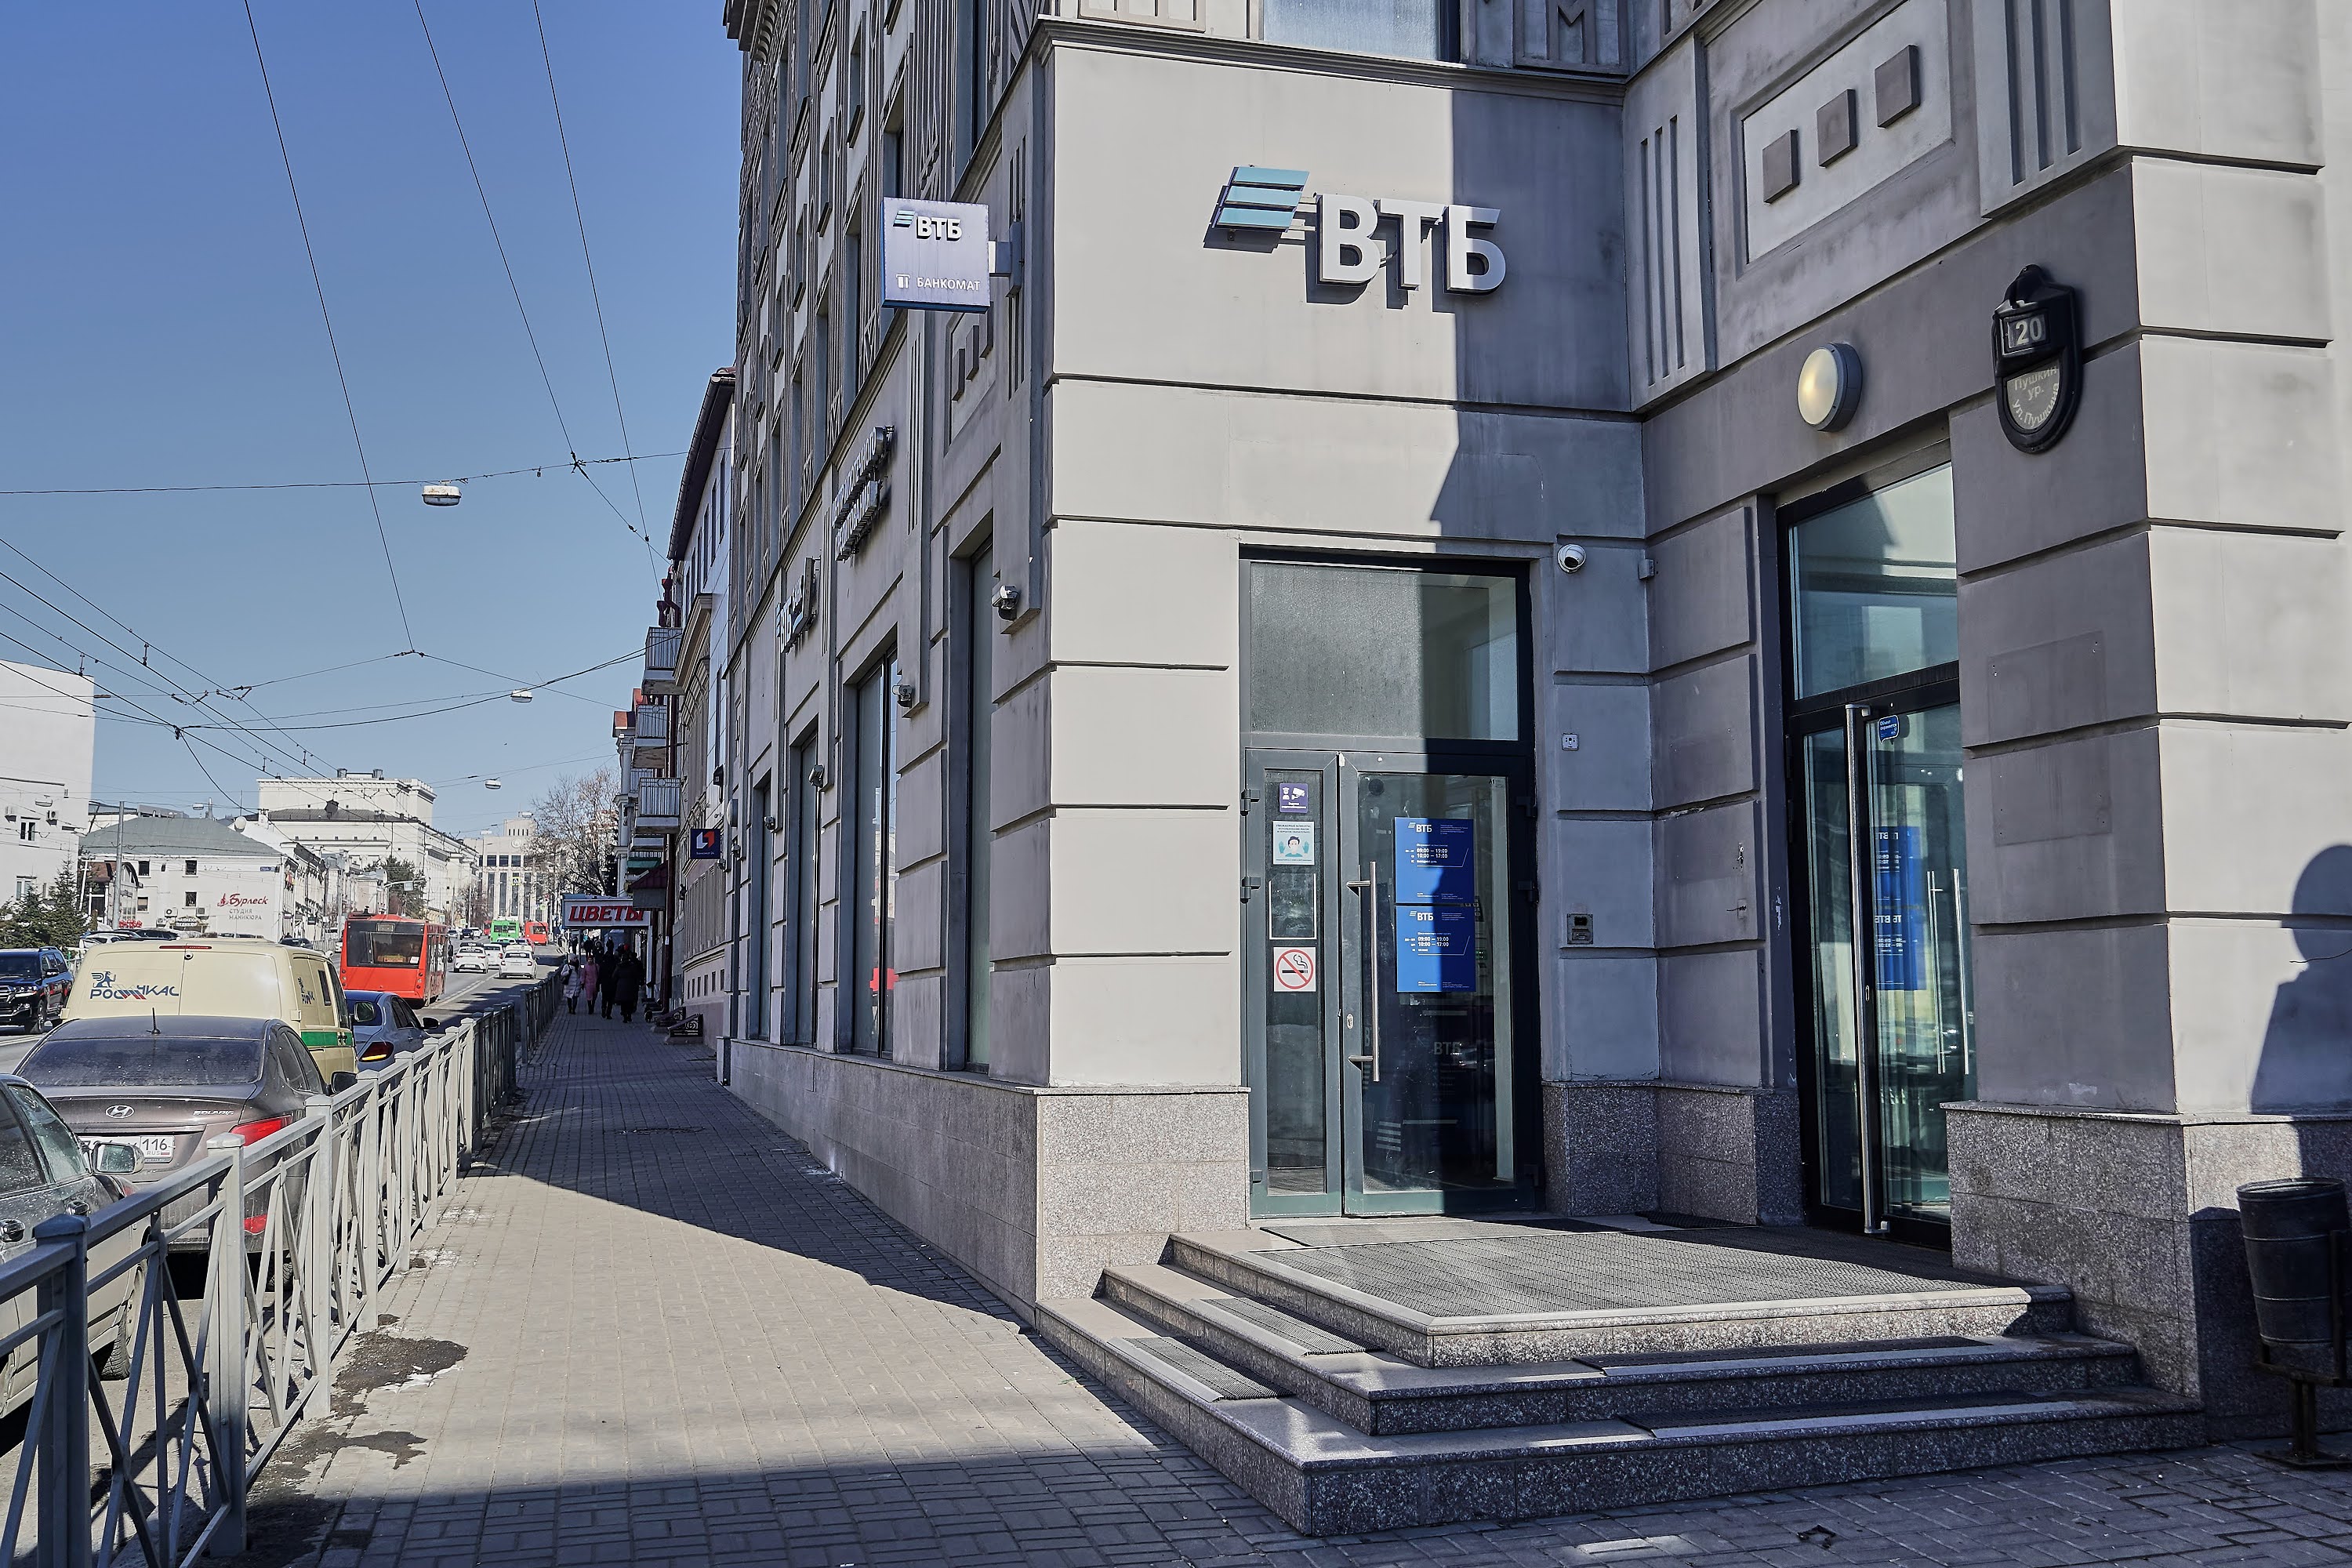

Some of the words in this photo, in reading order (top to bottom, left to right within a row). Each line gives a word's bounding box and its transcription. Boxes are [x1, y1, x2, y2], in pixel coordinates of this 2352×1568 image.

[916, 216, 962, 241] ВТБ
[1317, 193, 1506, 293] ВТБ
[916, 277, 981, 291] БАНКОМАТ
[2016, 317, 2042, 345] 20
[2013, 365, 2057, 390] Пушкин
[1416, 824, 1433, 833] ВТБ
[229, 893, 269, 907] Бурлеск
[568, 905, 646, 924] ЦВЕТЫ
[1417, 912, 1434, 921] ВТБ
[142, 1138, 168, 1152] 116
